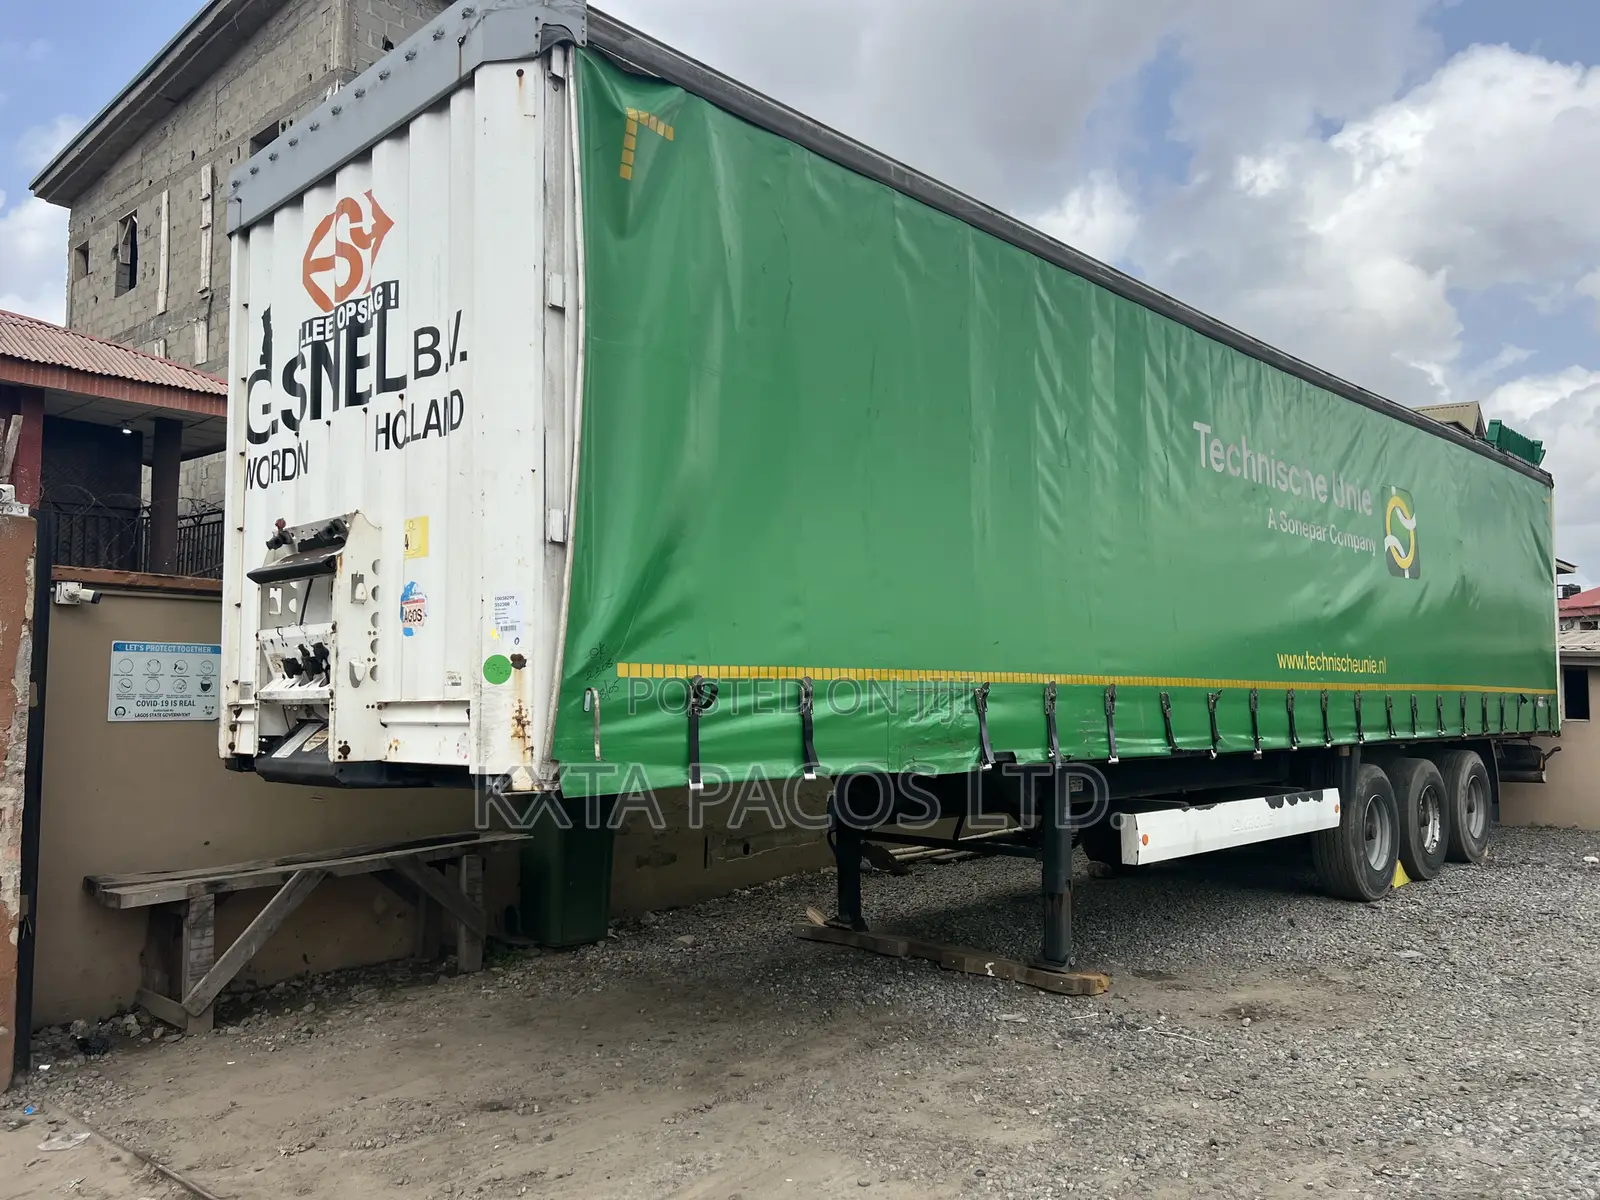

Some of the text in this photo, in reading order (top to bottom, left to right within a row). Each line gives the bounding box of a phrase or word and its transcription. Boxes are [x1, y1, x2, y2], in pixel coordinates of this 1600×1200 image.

[1193, 420, 1373, 516] Technische Unie
[1268, 508, 1376, 556] A Sonepar Company
[125, 643, 212, 653] LET'S PROTECT TOGETHER
[1277, 650, 1387, 674] www.technischeunie.nl
[136, 699, 196, 708] COVID-19 IS REAL
